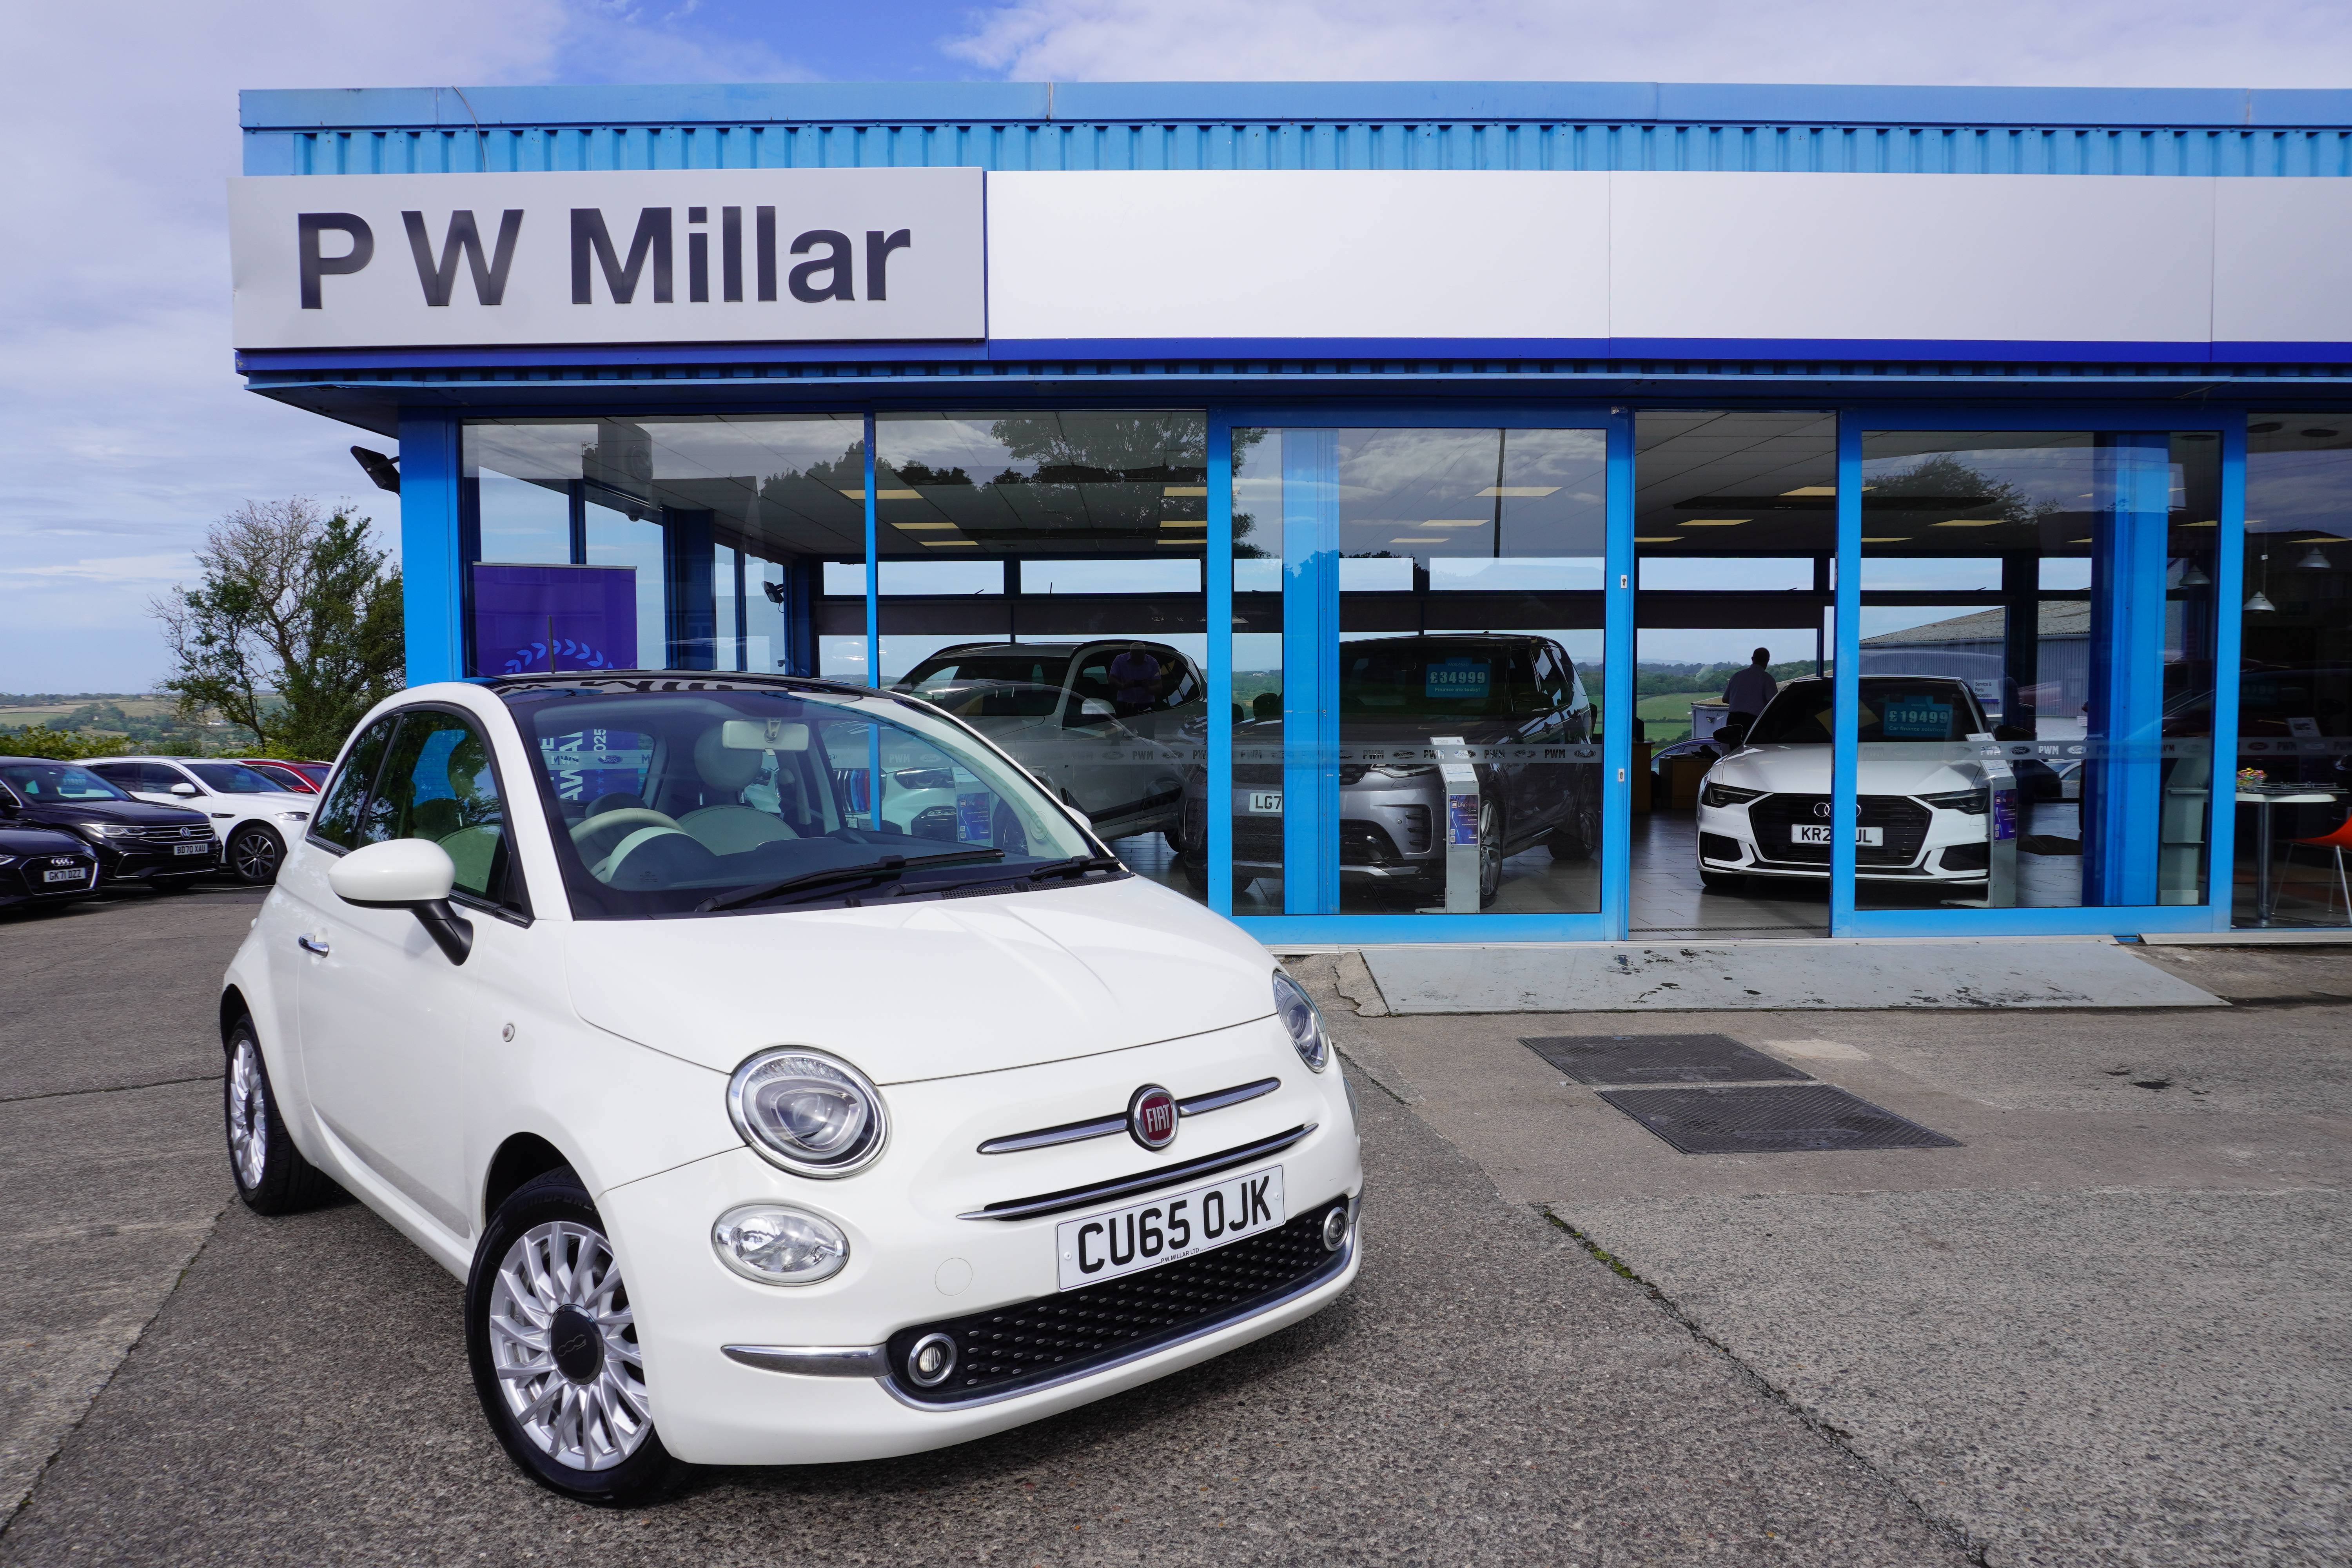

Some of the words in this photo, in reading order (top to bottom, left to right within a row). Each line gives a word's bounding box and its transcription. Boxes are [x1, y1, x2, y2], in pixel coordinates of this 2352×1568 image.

[298, 212, 374, 309] P
[401, 209, 524, 306] W
[570, 206, 911, 304] Millar
[1430, 671, 1485, 684] £34999
[1889, 710, 1949, 724] £19499
[1132, 750, 1153, 760] PWM
[1193, 750, 1207, 760] PW
[1363, 750, 1384, 759] PWM
[1424, 750, 1445, 759] PWM
[1485, 749, 1505, 759] PWM
[1545, 749, 1565, 759] PWM
[2038, 745, 2059, 755] PWM
[889, 753, 910, 763] PWM
[559, 731, 583, 800] AWA
[1255, 795, 1282, 809] LG7
[177, 846, 193, 854] BD70
[194, 844, 206, 853] XAU
[49, 871, 66, 880] GK71
[68, 869, 82, 878] DZZ
[1146, 1103, 1170, 1133] FIAT
[1078, 1200, 1191, 1274] CU65
[1203, 1175, 1271, 1240] OJK
